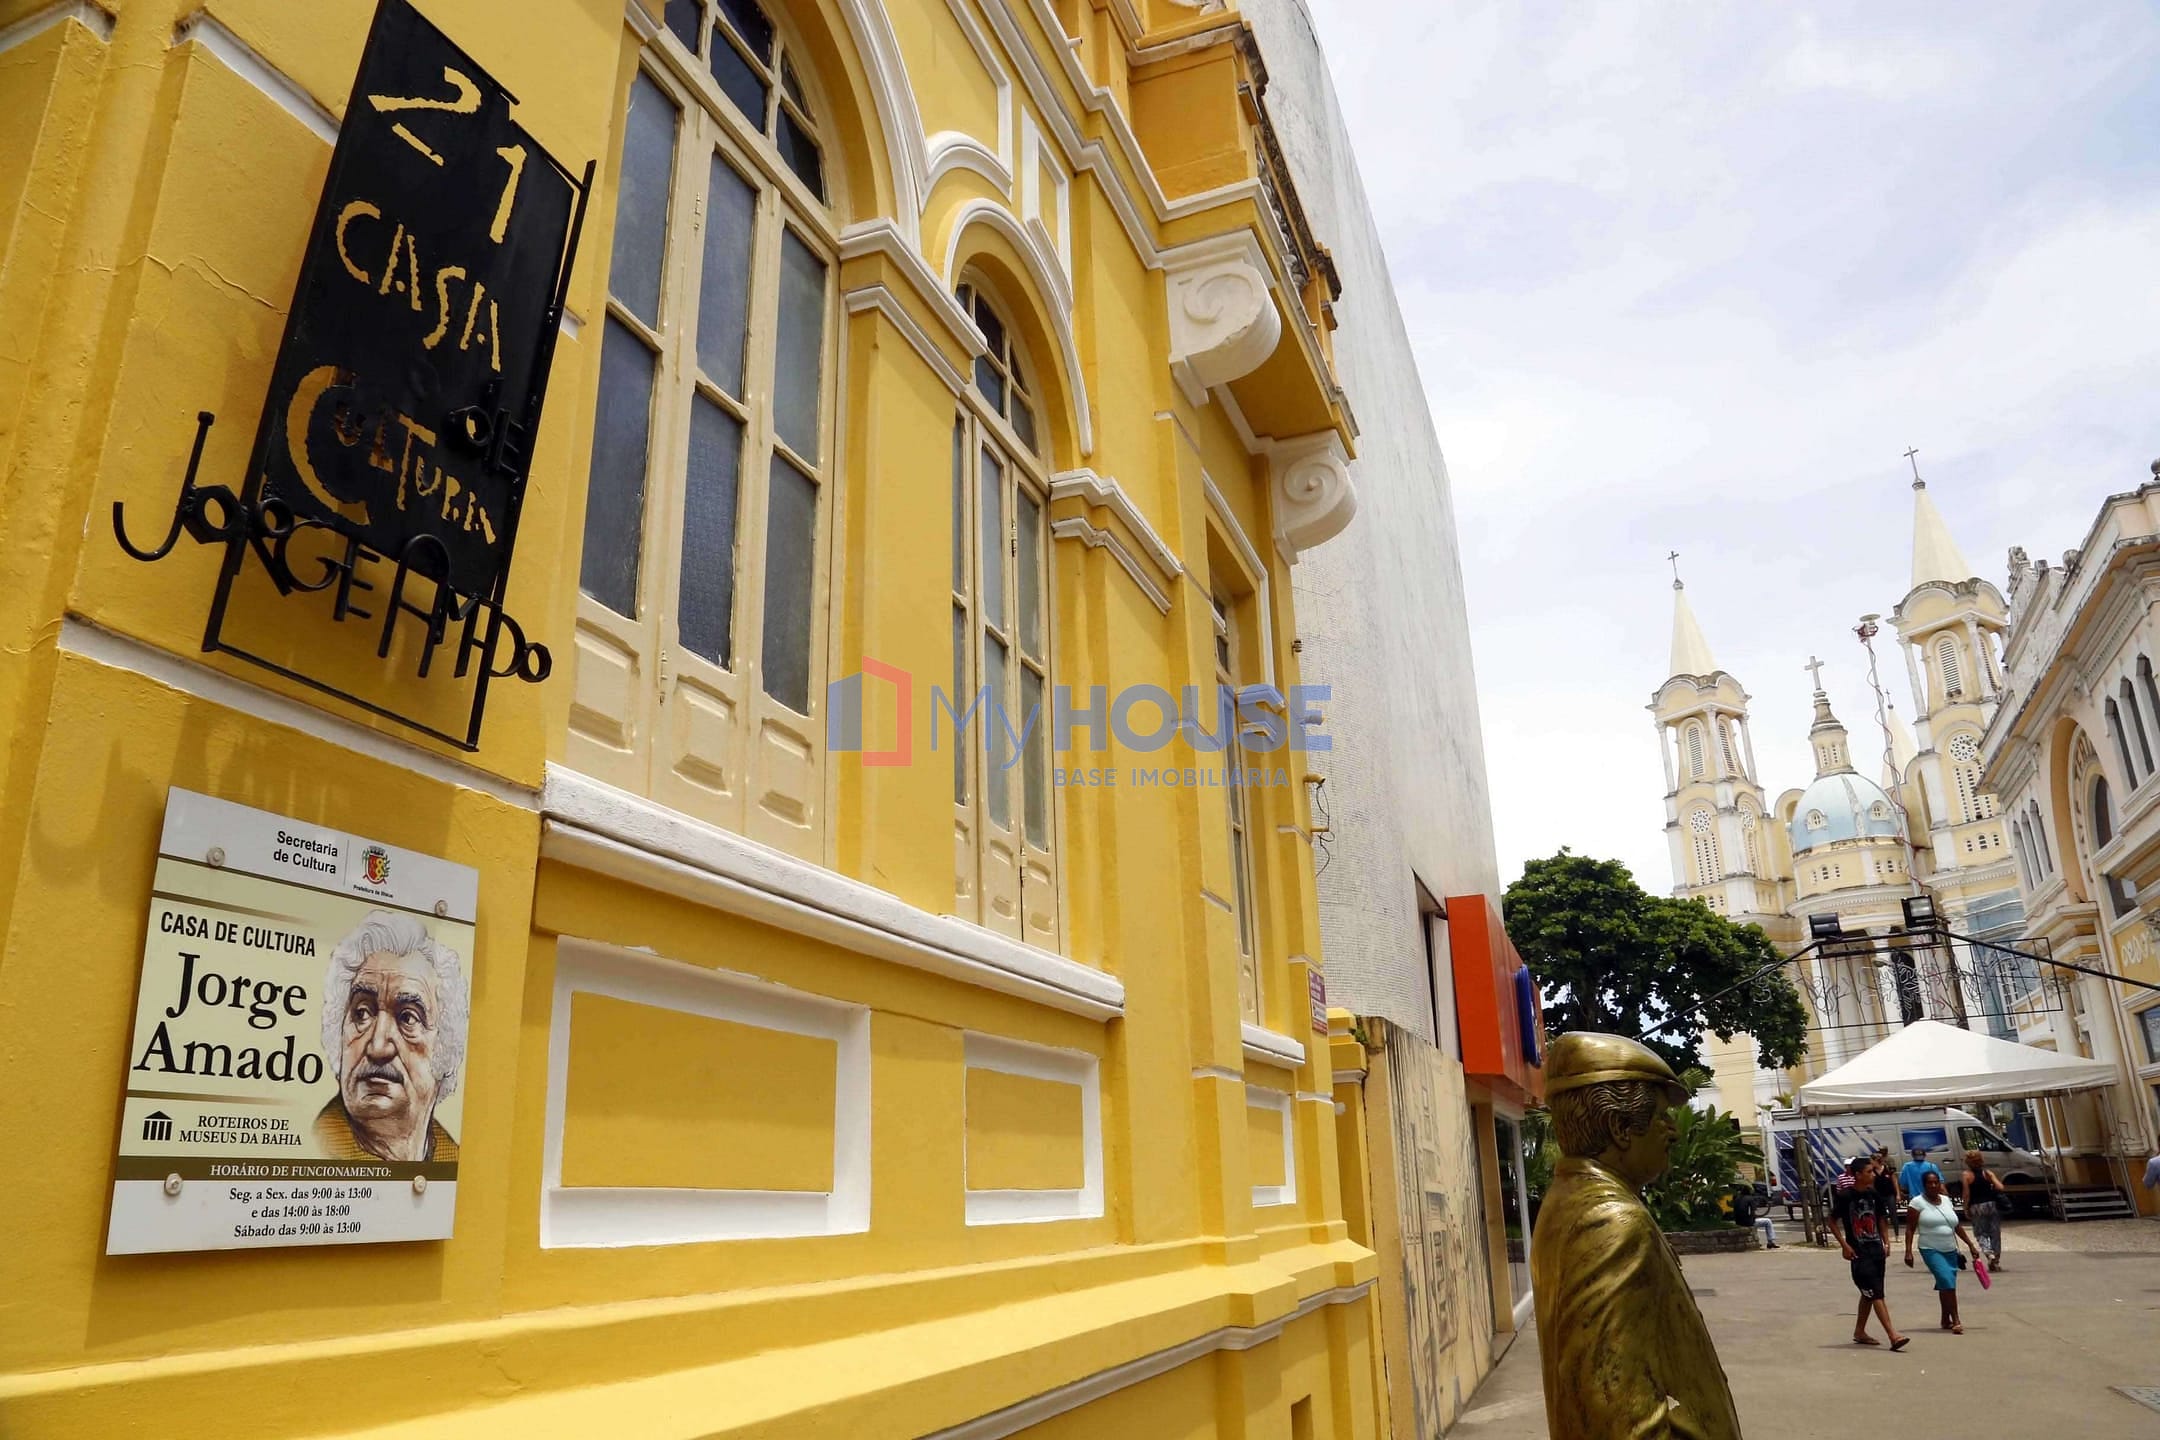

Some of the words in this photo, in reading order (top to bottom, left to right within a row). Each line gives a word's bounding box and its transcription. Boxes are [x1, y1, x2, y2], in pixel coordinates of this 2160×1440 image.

[335, 200, 501, 372] CASA
[276, 830, 339, 857] Secretaria
[273, 848, 290, 863] de
[292, 852, 337, 875] Cultura
[160, 911, 210, 939] CASA
[214, 920, 239, 944] DE
[242, 925, 316, 957] CULTURA
[165, 951, 308, 1030] Jorge
[132, 1020, 324, 1085] Amado
[197, 1115, 268, 1130] ROTEIROS
[269, 1118, 290, 1131] DE
[178, 1130, 237, 1144] MUSEUS
[239, 1132, 259, 1145] DA
[261, 1132, 303, 1146] BAHIA
[210, 1162, 270, 1177] HORÁRIO
[271, 1165, 290, 1177] DE
[290, 1166, 393, 1178] FUNCIONAMENTO:
[229, 1187, 253, 1204] Seg.
[255, 1192, 263, 1200] a
[265, 1187, 288, 1200] Sex.
[290, 1187, 309, 1200] das
[311, 1187, 333, 1200] 9:00
[334, 1187, 346, 1199] às
[348, 1187, 373, 1199] 13:00
[251, 1208, 259, 1219] e
[260, 1206, 281, 1218] das
[282, 1205, 310, 1218] 14:00
[311, 1204, 323, 1217] às
[325, 1204, 351, 1217] 18:00
[233, 1224, 276, 1238] Sábado
[277, 1224, 297, 1236] das
[299, 1223, 321, 1235] 9:00
[322, 1222, 334, 1235] às
[336, 1221, 362, 1234] 13:00
